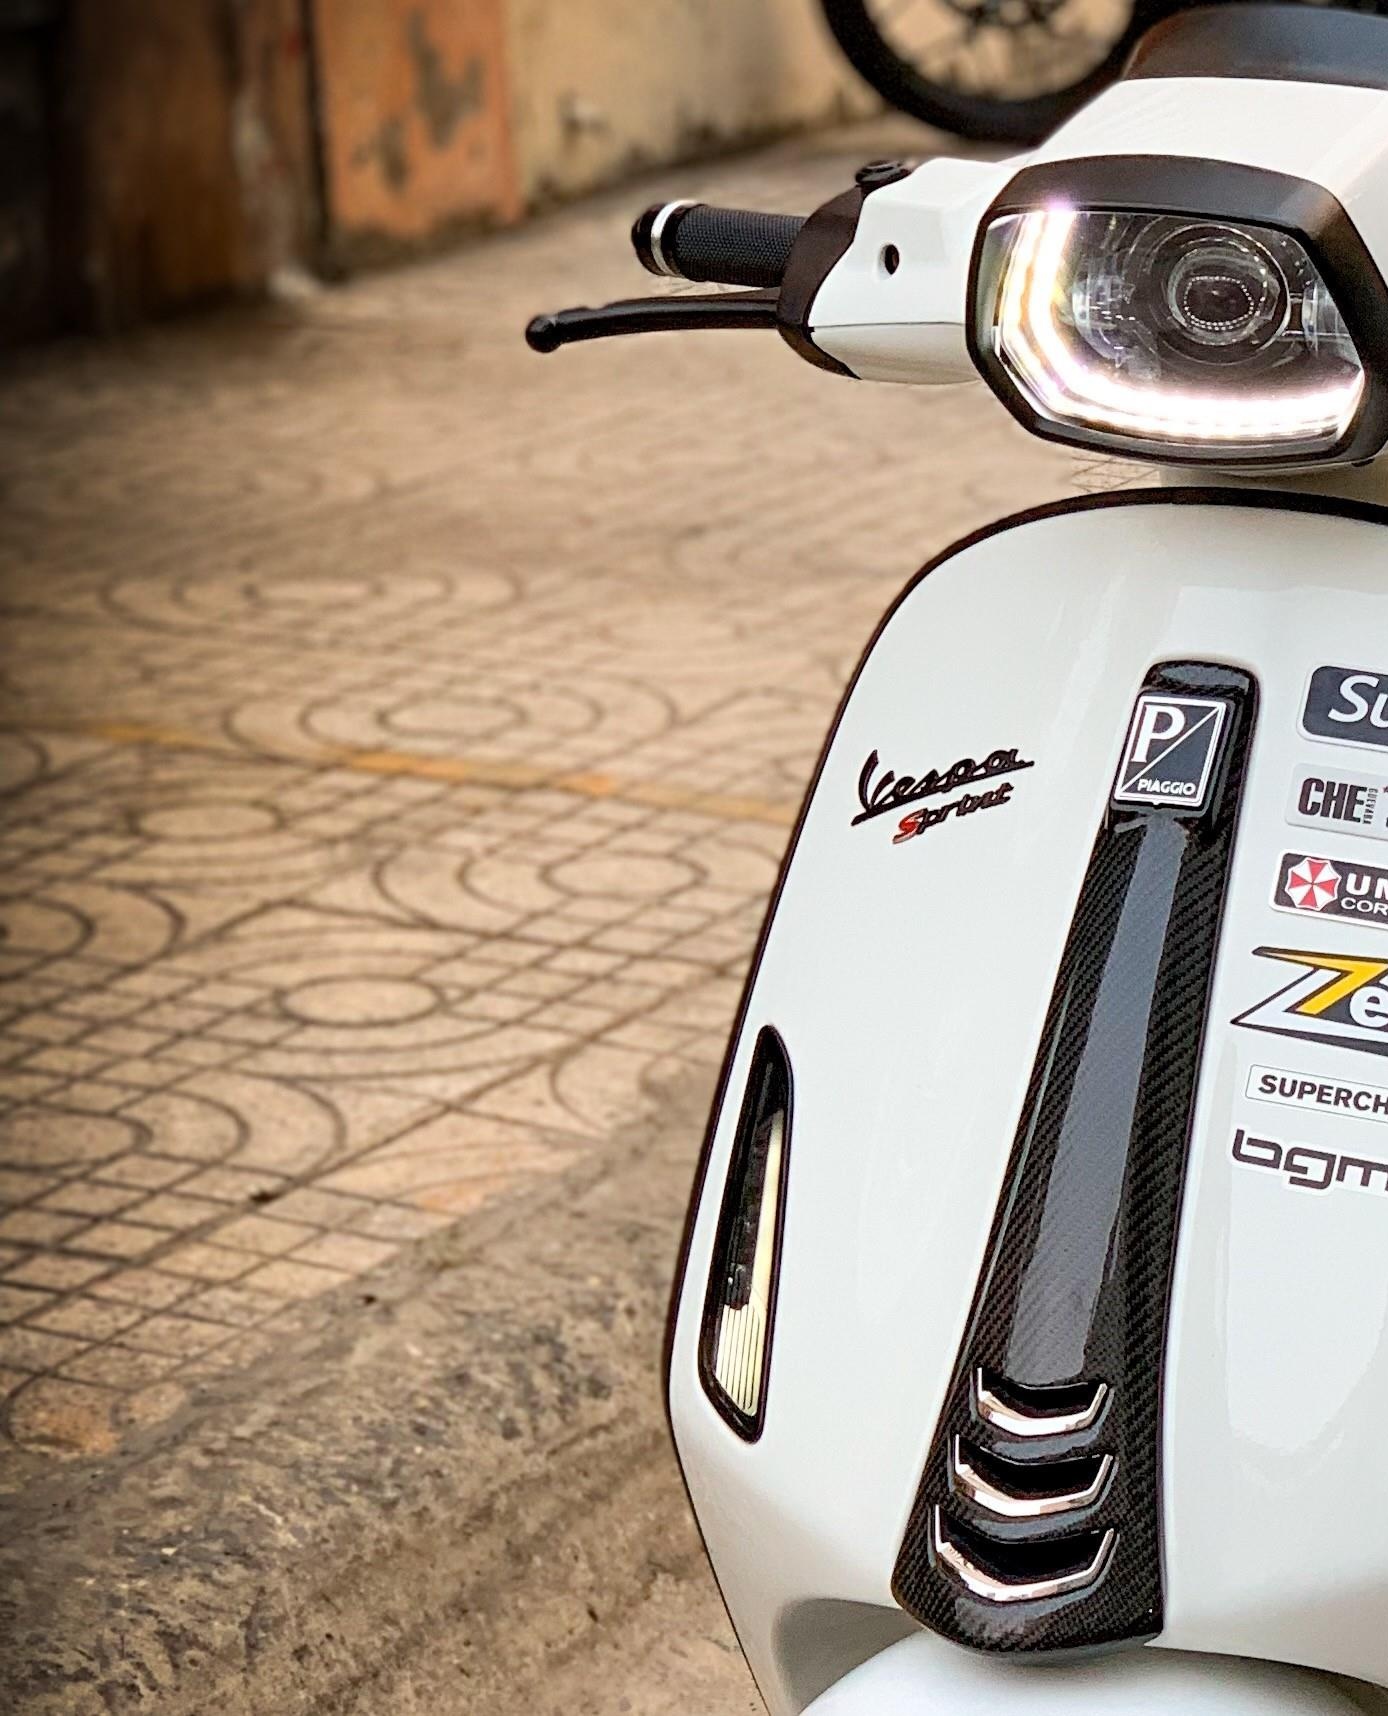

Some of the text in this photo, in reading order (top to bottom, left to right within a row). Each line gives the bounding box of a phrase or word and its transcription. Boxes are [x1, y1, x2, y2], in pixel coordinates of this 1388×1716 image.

[1131, 704, 1185, 763] P
[851, 749, 1034, 826] Vespa
[1137, 778, 1197, 797] PIAGGIO
[1298, 777, 1368, 823] CHE
